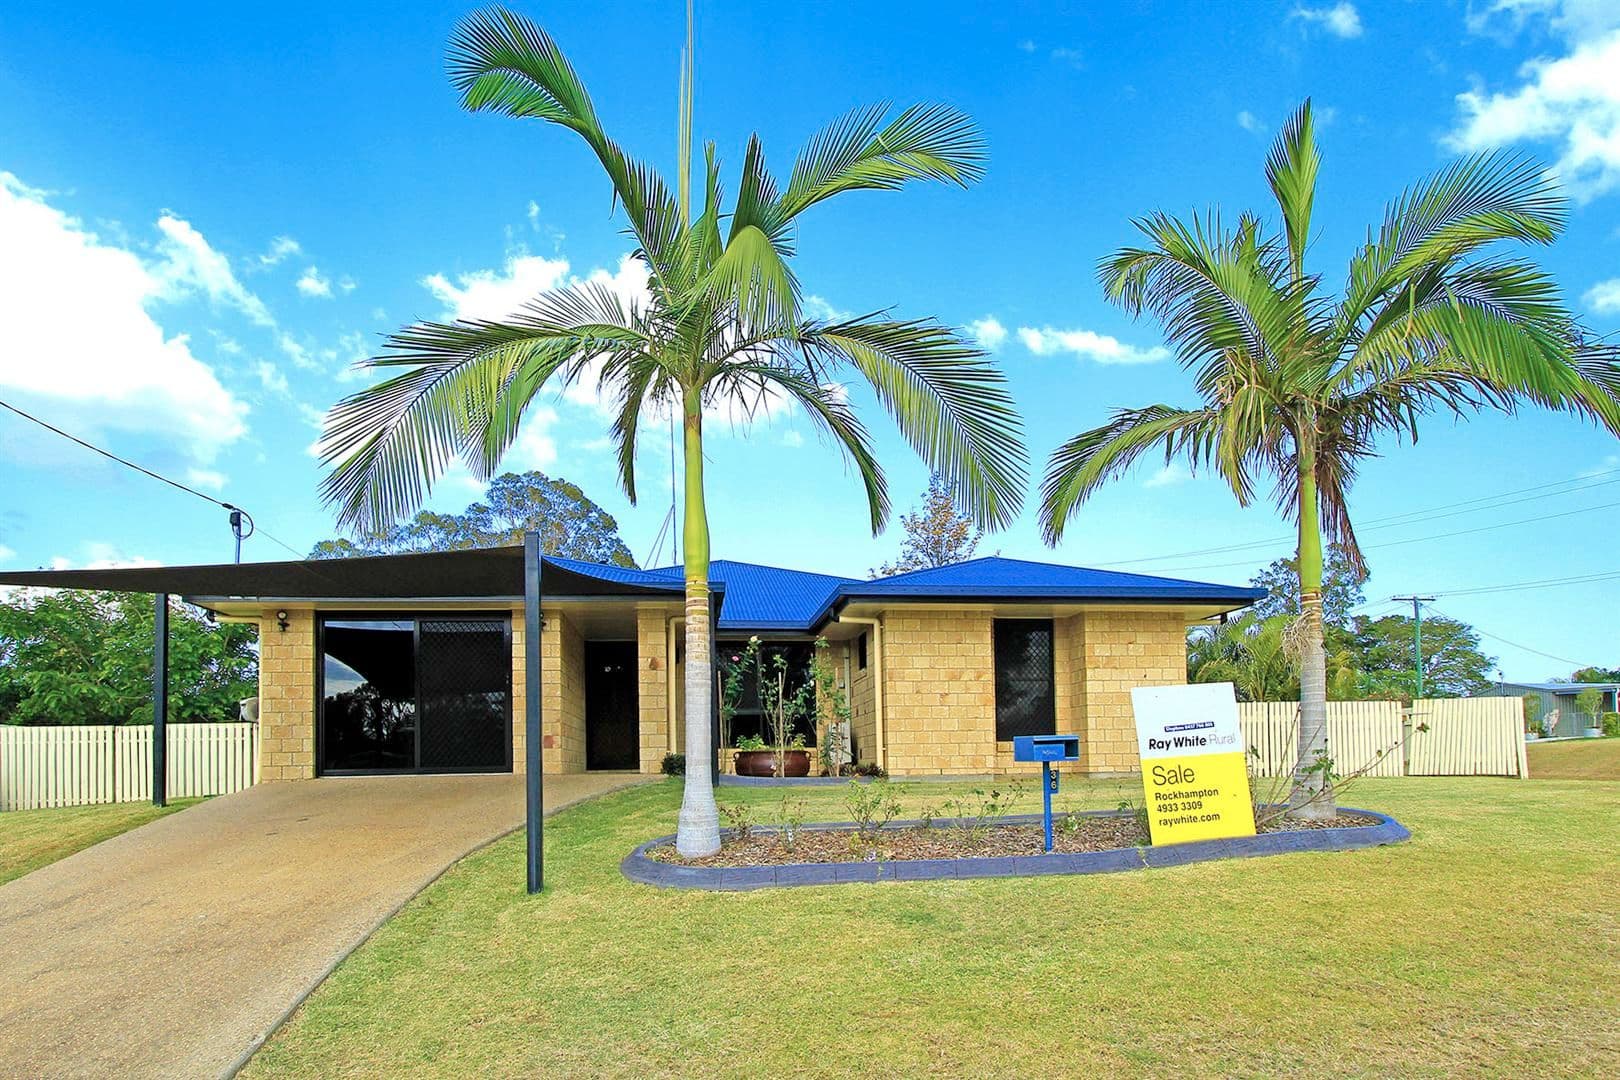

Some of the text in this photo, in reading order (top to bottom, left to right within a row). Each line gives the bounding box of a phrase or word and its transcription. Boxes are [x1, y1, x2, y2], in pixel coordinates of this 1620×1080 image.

[1149, 733, 1236, 751] Ray White Rural
[1152, 764, 1195, 786] Sale
[1155, 788, 1219, 801] Rockhampton
[1157, 800, 1203, 813] 4933 3309
[1159, 813, 1221, 827] raywhite.com
